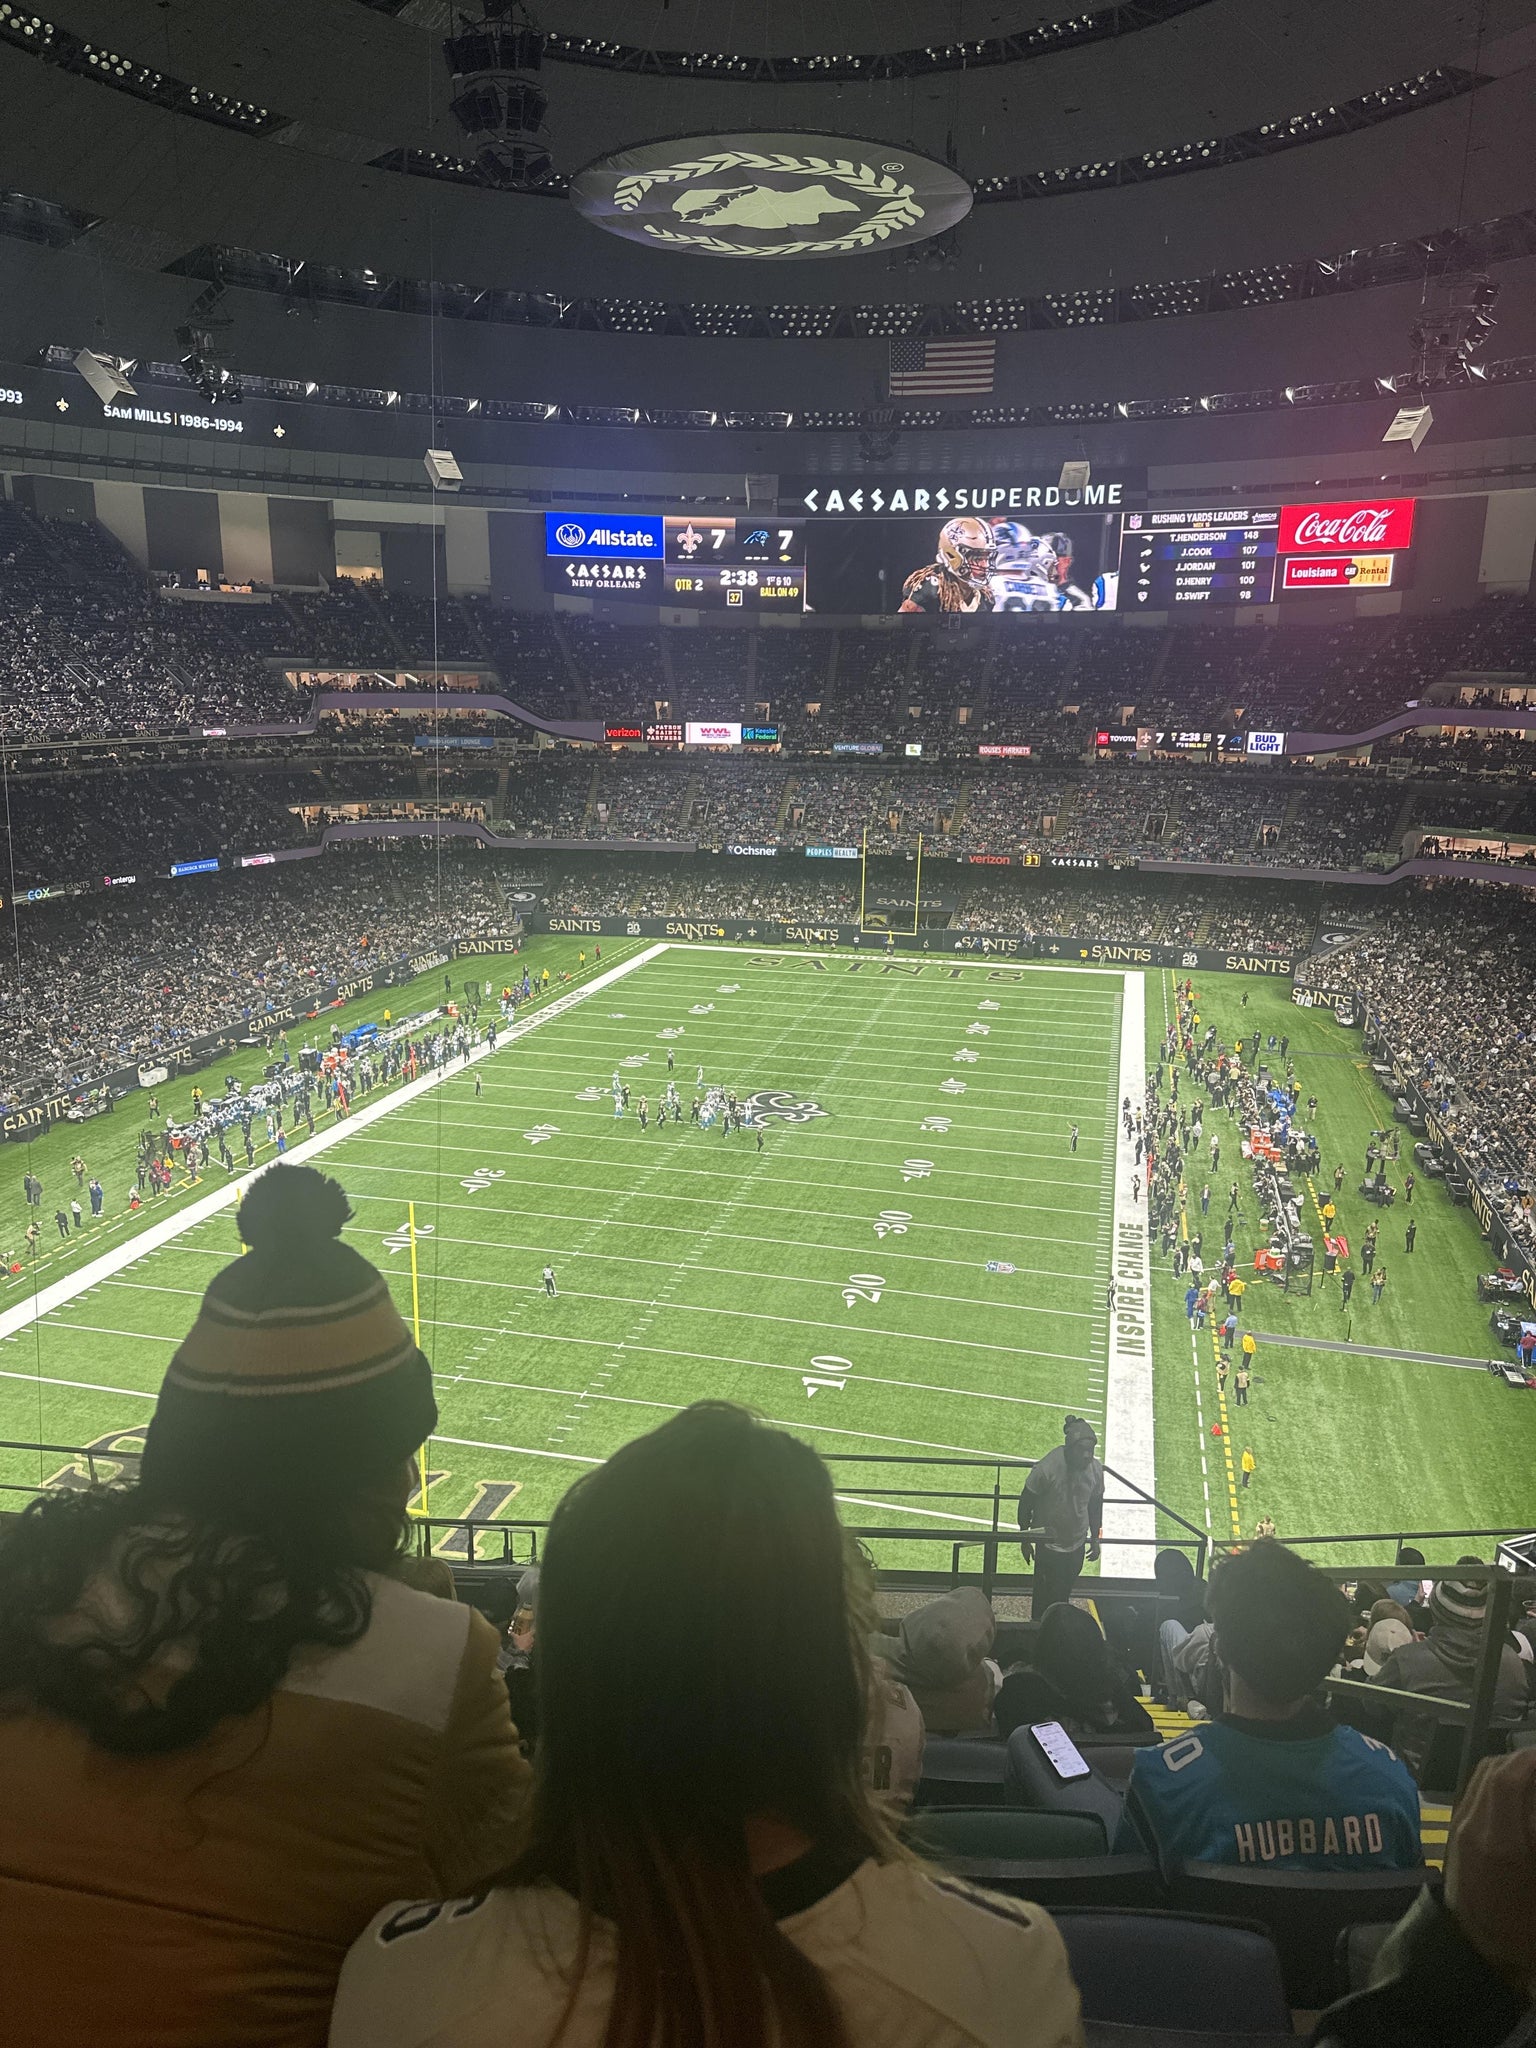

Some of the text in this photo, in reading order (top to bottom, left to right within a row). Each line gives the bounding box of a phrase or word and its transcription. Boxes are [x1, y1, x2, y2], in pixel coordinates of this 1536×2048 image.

[104, 405, 243, 432] SAM MILLS 1986-1994
[804, 484, 1123, 512] CAESARS SUPERDOME
[1152, 514, 1185, 524] RUSHING
[1186, 513, 1212, 523] YARDS
[1212, 511, 1249, 521] LEADERS
[1294, 508, 1395, 544] Coca-Cola
[587, 529, 654, 547] Allstate
[711, 529, 725, 549] 7
[778, 530, 793, 549] 7
[1170, 531, 1259, 542] T.HENDERSON 148
[1181, 546, 1257, 556] J.COOK 107
[566, 563, 646, 579] CAESARS
[1175, 561, 1255, 571] J.JORDAN 101
[720, 570, 758, 586] 2:38
[1291, 567, 1337, 578] Louisiana
[572, 579, 641, 588] NEW ORLEANS
[675, 579, 703, 591] QTR 2
[782, 576, 792, 586] 10
[1176, 576, 1255, 586] D.HENRY 100
[730, 593, 740, 603] 37
[760, 587, 799, 597] BALL ON 49
[1176, 591, 1251, 600] D.SWIFT 98
[81, 732, 106, 740] SAINTS
[135, 729, 159, 737] SAINTS
[606, 727, 640, 737] verizon
[1179, 732, 1200, 742] 2:38
[24, 735, 50, 743] SAINTS
[1156, 733, 1165, 744] 7
[1217, 734, 1226, 746] 7
[1255, 734, 1277, 743] BUD
[833, 743, 859, 751] VENTURE
[979, 745, 1030, 754] ROUSES MARKETS
[1250, 742, 1280, 752] LIGHT
[1438, 760, 1467, 768] SAINTS
[733, 845, 776, 856] Ochsner
[807, 848, 857, 856] PEOPLES HEALTH
[867, 848, 892, 856] SAINTS
[924, 850, 948, 858] SAINTS
[969, 854, 1010, 864] verizon
[1051, 858, 1099, 868] CAESARS
[1108, 858, 1135, 867] SAINTS
[66, 880, 90, 890] SAINTS
[112, 875, 136, 884] entergy
[28, 888, 50, 900] COX
[876, 897, 943, 908] SAINTS
[549, 919, 601, 932] SAINTS
[627, 923, 641, 934] 20
[666, 922, 718, 936] SAINTS
[786, 927, 839, 941] SAINTS
[458, 939, 514, 954] SAINTS
[1092, 945, 1151, 962] SAINTS
[1182, 953, 1197, 966] 20
[745, 956, 1025, 982] SAINTS
[1226, 956, 1290, 973] SAINTS
[249, 1006, 293, 1032] SAINTS
[965, 1024, 991, 1035] 20
[618, 1052, 650, 1067] 40
[953, 1051, 980, 1063] 30
[575, 1086, 612, 1101] 50
[938, 1080, 967, 1095] 40
[919, 1116, 952, 1133] 50
[522, 1123, 560, 1141] 40
[900, 1159, 934, 1179] 40
[459, 1167, 506, 1189] 30
[1466, 1178, 1493, 1232] SAINTS
[873, 1210, 913, 1234] 30
[381, 1222, 435, 1248] 20
[841, 1273, 886, 1304] 20
[1116, 1222, 1146, 1357] INSPIRE CHANGE
[802, 1355, 853, 1391] 10
[1234, 1812, 1383, 1864] HUBBARD
